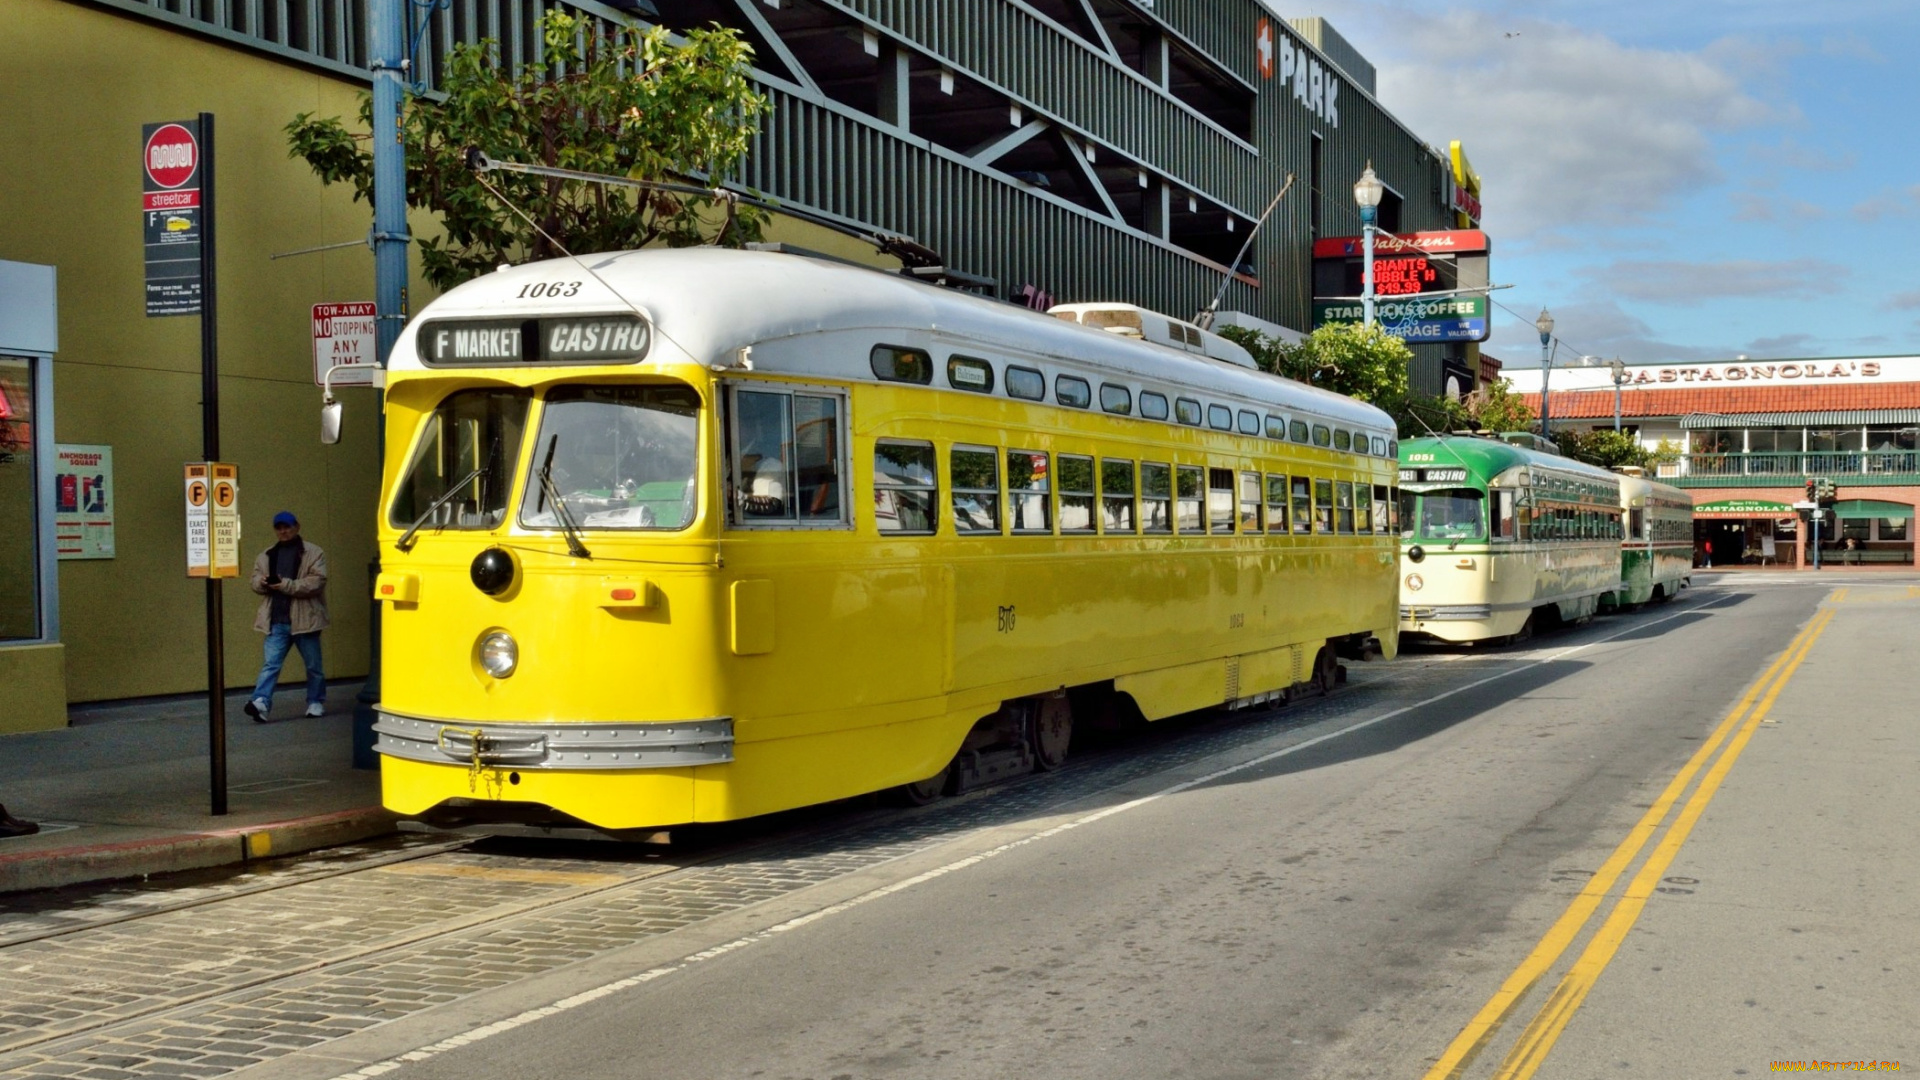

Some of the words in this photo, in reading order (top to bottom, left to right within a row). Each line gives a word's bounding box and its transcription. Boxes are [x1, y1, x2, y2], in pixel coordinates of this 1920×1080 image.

[1280, 34, 1338, 128] PARK
[152, 193, 192, 207] streetcar
[150, 212, 157, 227] F
[1373, 258, 1427, 272] GIANTS
[1362, 270, 1418, 284] UBBLE
[1424, 269, 1435, 281] H
[516, 281, 582, 299] 1063
[1377, 282, 1421, 295] $19.99
[317, 305, 372, 317] TOW-AWAY
[1325, 304, 1413, 319] STARUCKS
[1417, 302, 1475, 316] COFFEE
[315, 318, 332, 337] NO
[334, 321, 374, 336] STOPPING
[1448, 329, 1480, 338] VALIDATE
[437, 332, 448, 359] F
[456, 328, 522, 358] MARKET
[550, 322, 649, 353] CASTRO
[333, 340, 359, 354] ANY
[331, 356, 361, 366] TIME
[1611, 363, 1881, 384] CASTAGNOLA'S
[1408, 454, 1435, 462] 1051
[1427, 470, 1467, 481] CASTRO
[193, 486, 203, 503] F
[219, 487, 229, 503] F
[215, 521, 234, 529] EXACT
[218, 529, 232, 537] FARE
[191, 537, 206, 545] $2.00
[218, 537, 233, 545] $2.00
